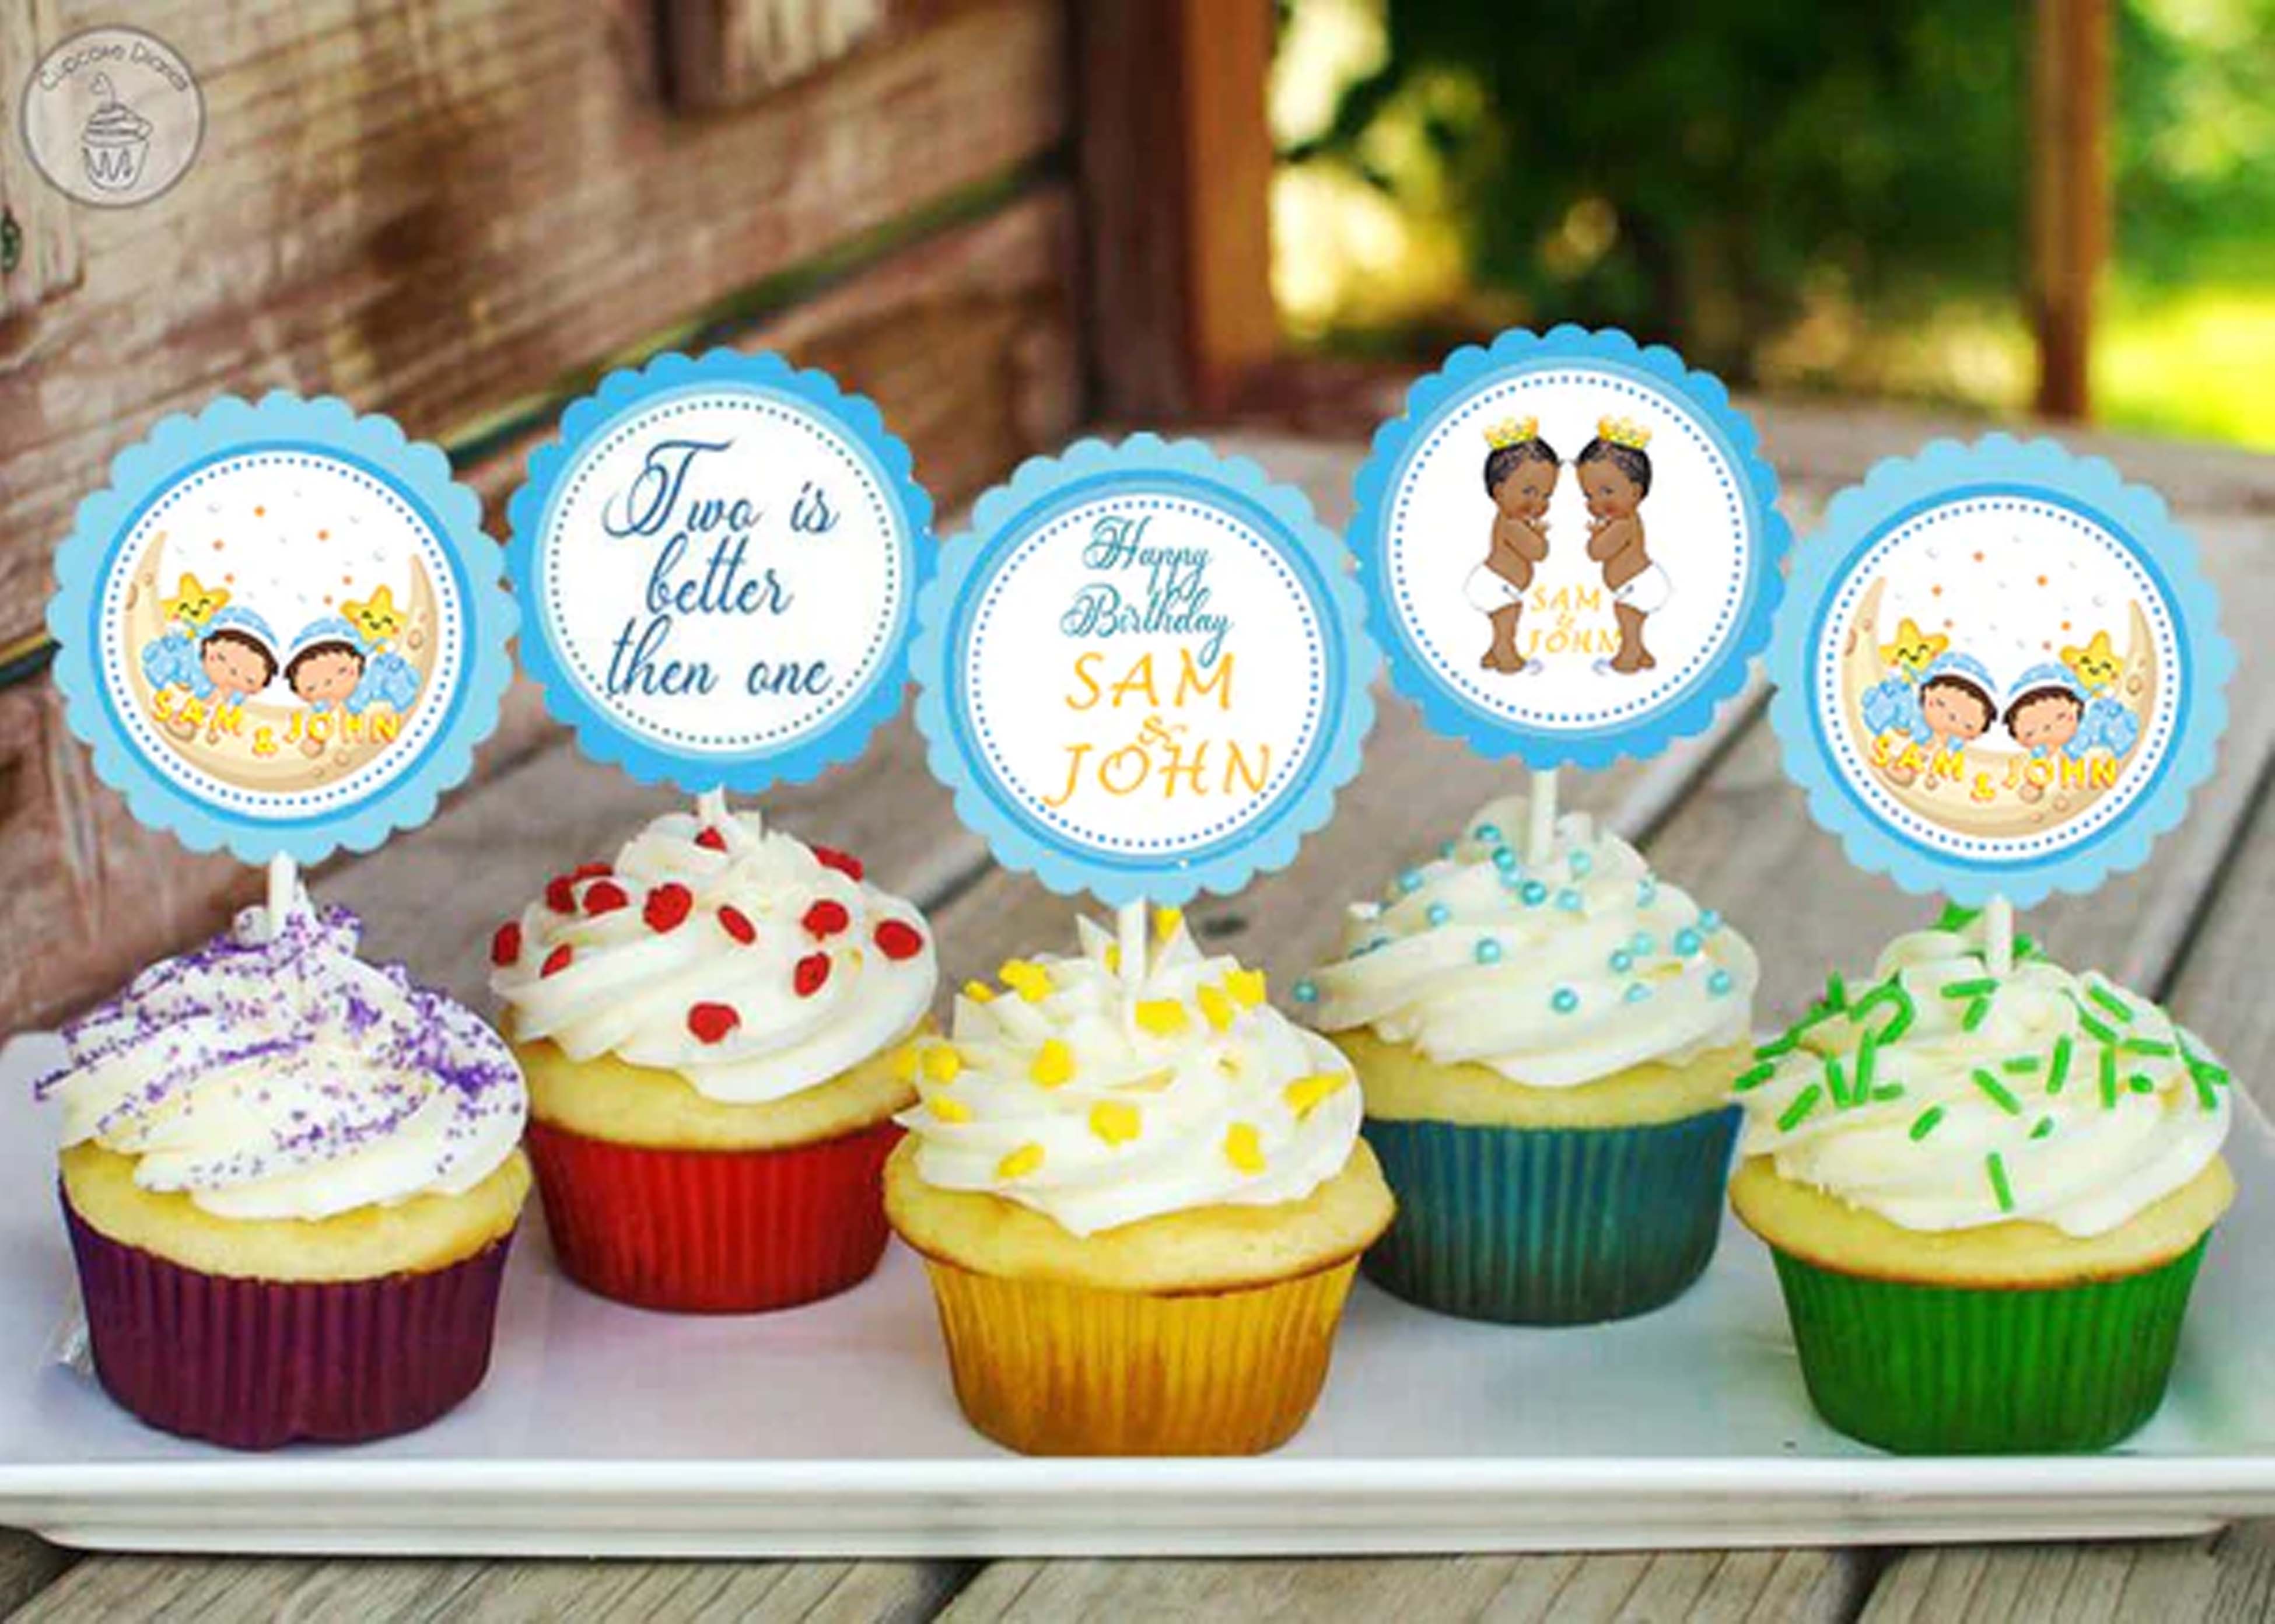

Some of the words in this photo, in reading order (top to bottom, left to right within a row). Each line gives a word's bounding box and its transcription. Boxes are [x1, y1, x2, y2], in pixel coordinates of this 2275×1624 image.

[601, 436, 765, 537] Two
[789, 480, 841, 534] is
[645, 531, 794, 614] better
[1082, 514, 1213, 602] Happy
[1059, 582, 1234, 669] Birthday
[1528, 582, 1601, 613] SAM
[606, 614, 719, 697] then
[746, 660, 834, 696] one
[1065, 646, 1236, 712] SAM
[1520, 628, 1625, 661] JOHN
[150, 688, 243, 736] SAM
[253, 726, 279, 757] &
[282, 710, 401, 744] JOHN
[1136, 713, 1189, 751] &
[1041, 739, 1270, 808] JOHN
[1870, 735, 1966, 782] SAM
[1969, 771, 1997, 803] &
[2001, 756, 2118, 790] JOHN
